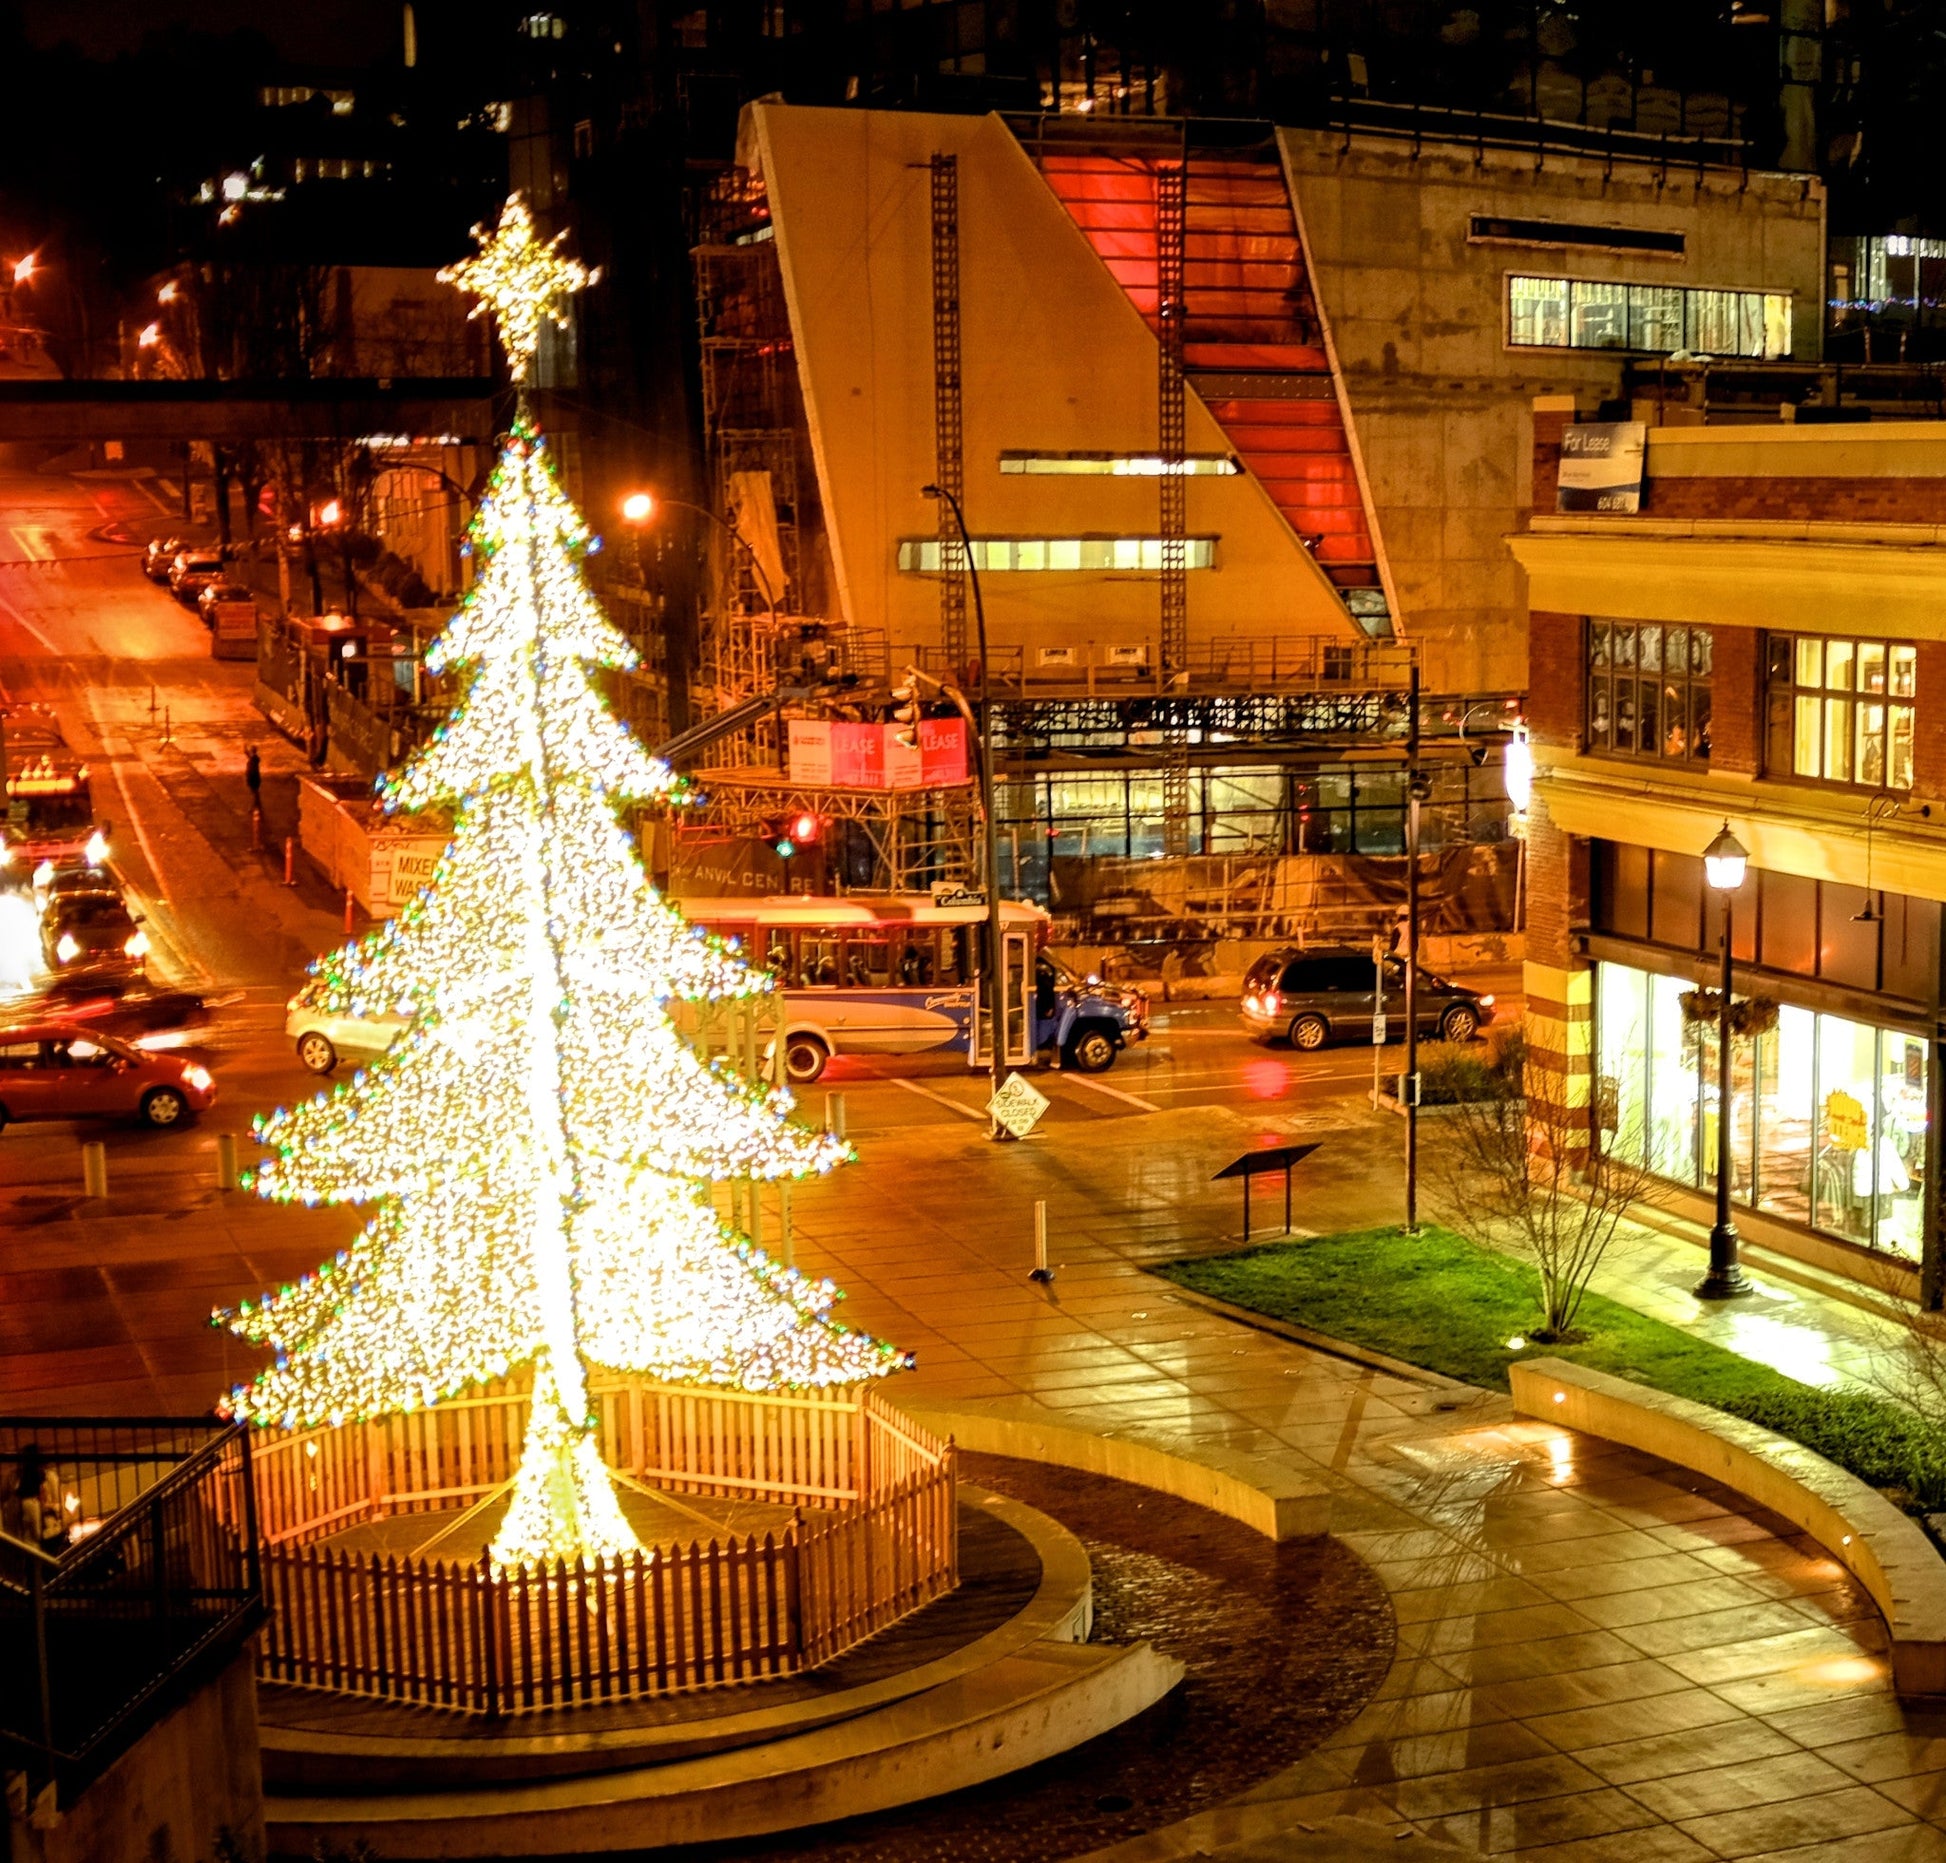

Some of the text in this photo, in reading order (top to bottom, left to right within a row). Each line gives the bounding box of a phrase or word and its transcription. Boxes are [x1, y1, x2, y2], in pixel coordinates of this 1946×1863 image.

[1563, 433, 1610, 451] For Lease
[835, 738, 876, 756] LEASE
[922, 732, 959, 752] LEASE
[694, 865, 815, 895] ANVIL CENRE
